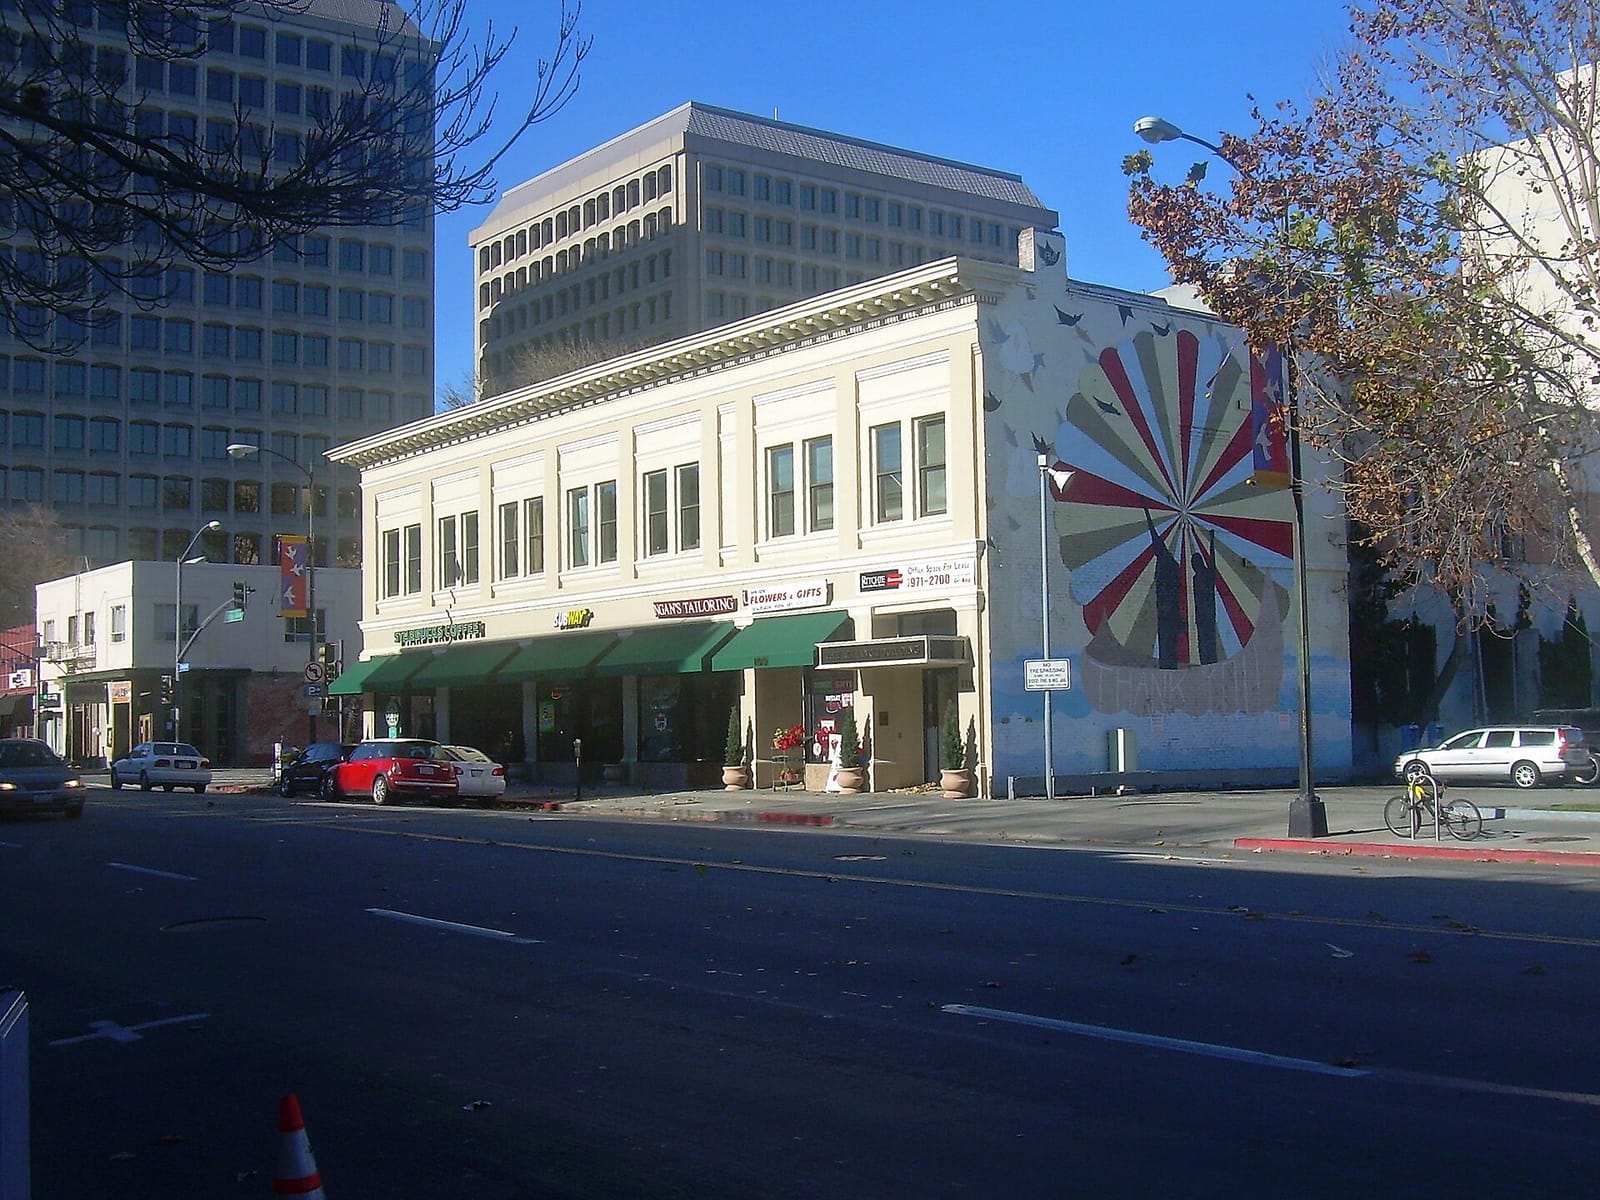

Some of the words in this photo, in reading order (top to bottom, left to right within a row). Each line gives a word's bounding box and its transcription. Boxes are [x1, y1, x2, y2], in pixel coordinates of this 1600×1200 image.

[750, 592, 788, 605] FLOWERS
[796, 587, 822, 599] GIFTS
[682, 597, 734, 614] TAILORING
[553, 609, 587, 627] SUBWAY
